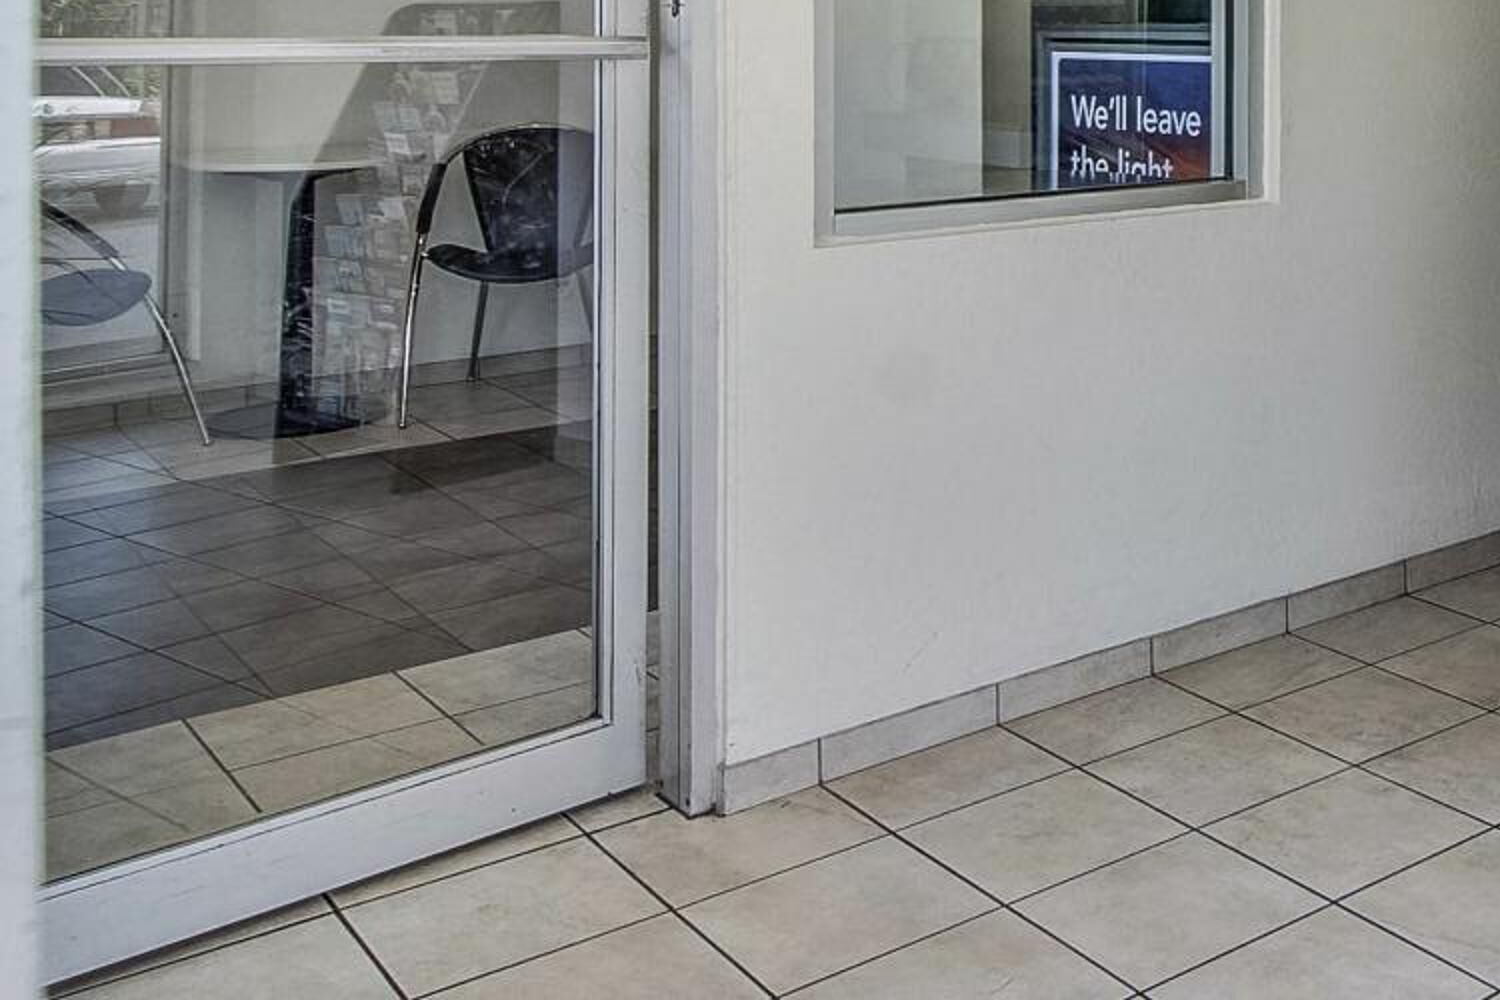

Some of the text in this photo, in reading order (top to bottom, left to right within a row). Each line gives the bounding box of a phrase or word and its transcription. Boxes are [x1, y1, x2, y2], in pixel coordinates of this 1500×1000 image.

[1070, 94, 1202, 137] We'll leave
[1070, 145, 1174, 183] the light
